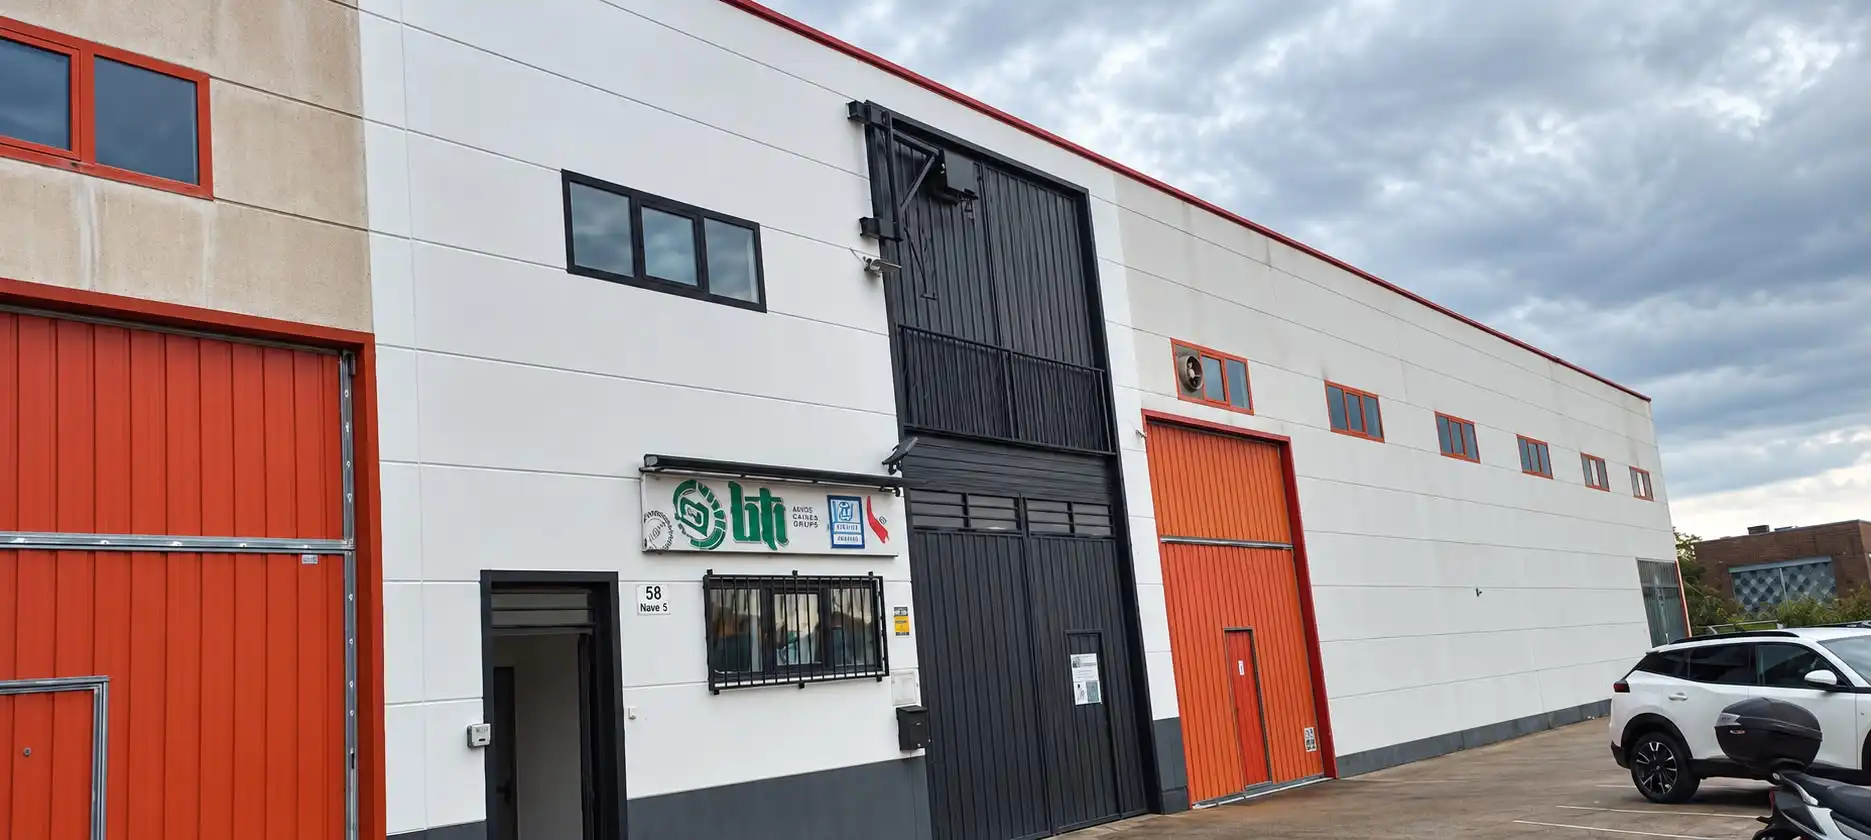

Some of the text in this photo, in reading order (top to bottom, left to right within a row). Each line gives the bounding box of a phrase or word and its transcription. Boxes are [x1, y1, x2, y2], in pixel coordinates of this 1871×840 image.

[646, 586, 662, 600] 58
[640, 603, 668, 612] Nave 5
